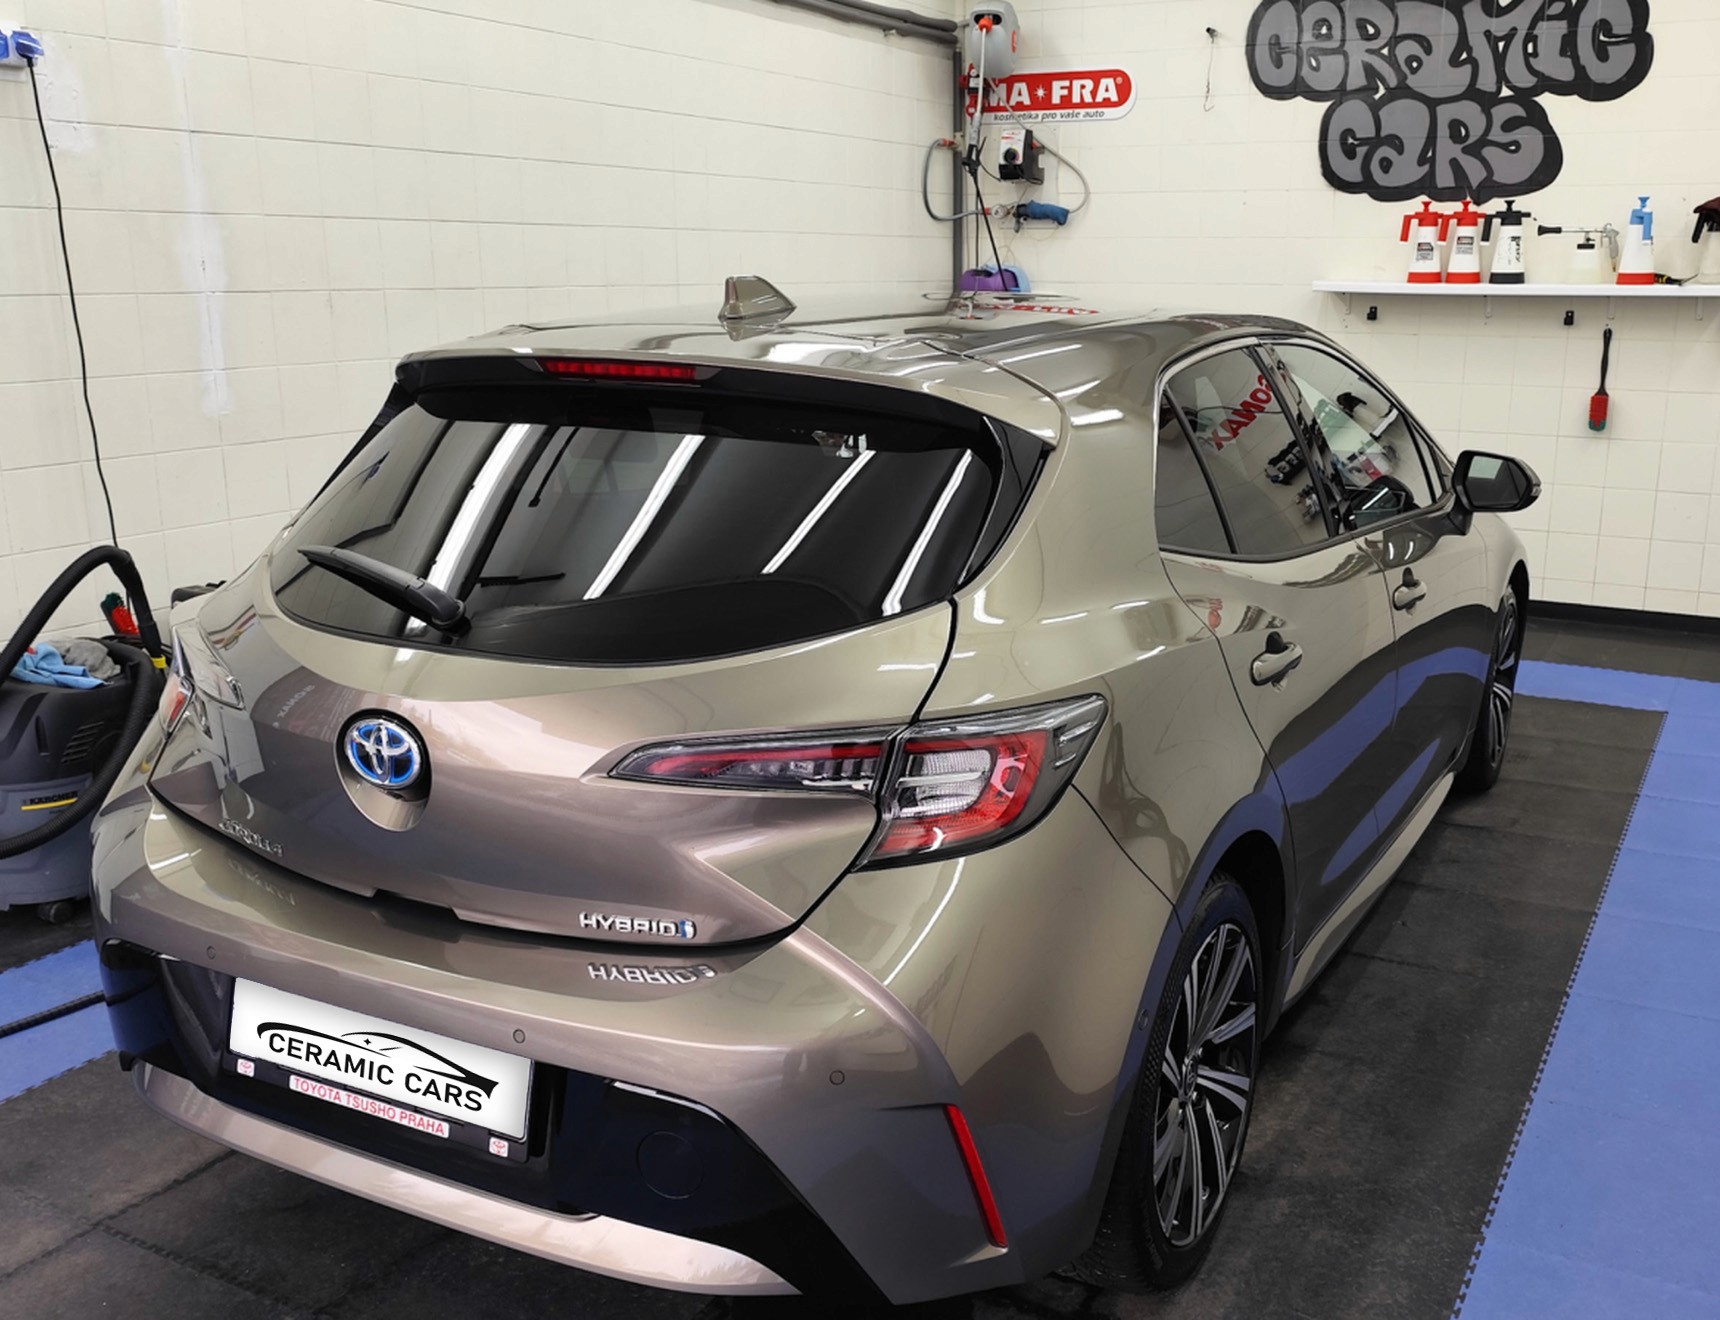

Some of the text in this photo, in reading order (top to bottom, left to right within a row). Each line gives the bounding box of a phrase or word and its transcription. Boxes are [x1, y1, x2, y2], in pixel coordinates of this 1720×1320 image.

[1052, 78, 1118, 105] FRA
[1041, 111, 1057, 122] pro
[1060, 110, 1081, 119] vaše
[1082, 110, 1105, 118] auto
[579, 912, 677, 937] HYBRID
[268, 1033, 482, 1112] CERAMIC CARS
[294, 1077, 445, 1135] TOYOTA TSUSHO PRAHA
